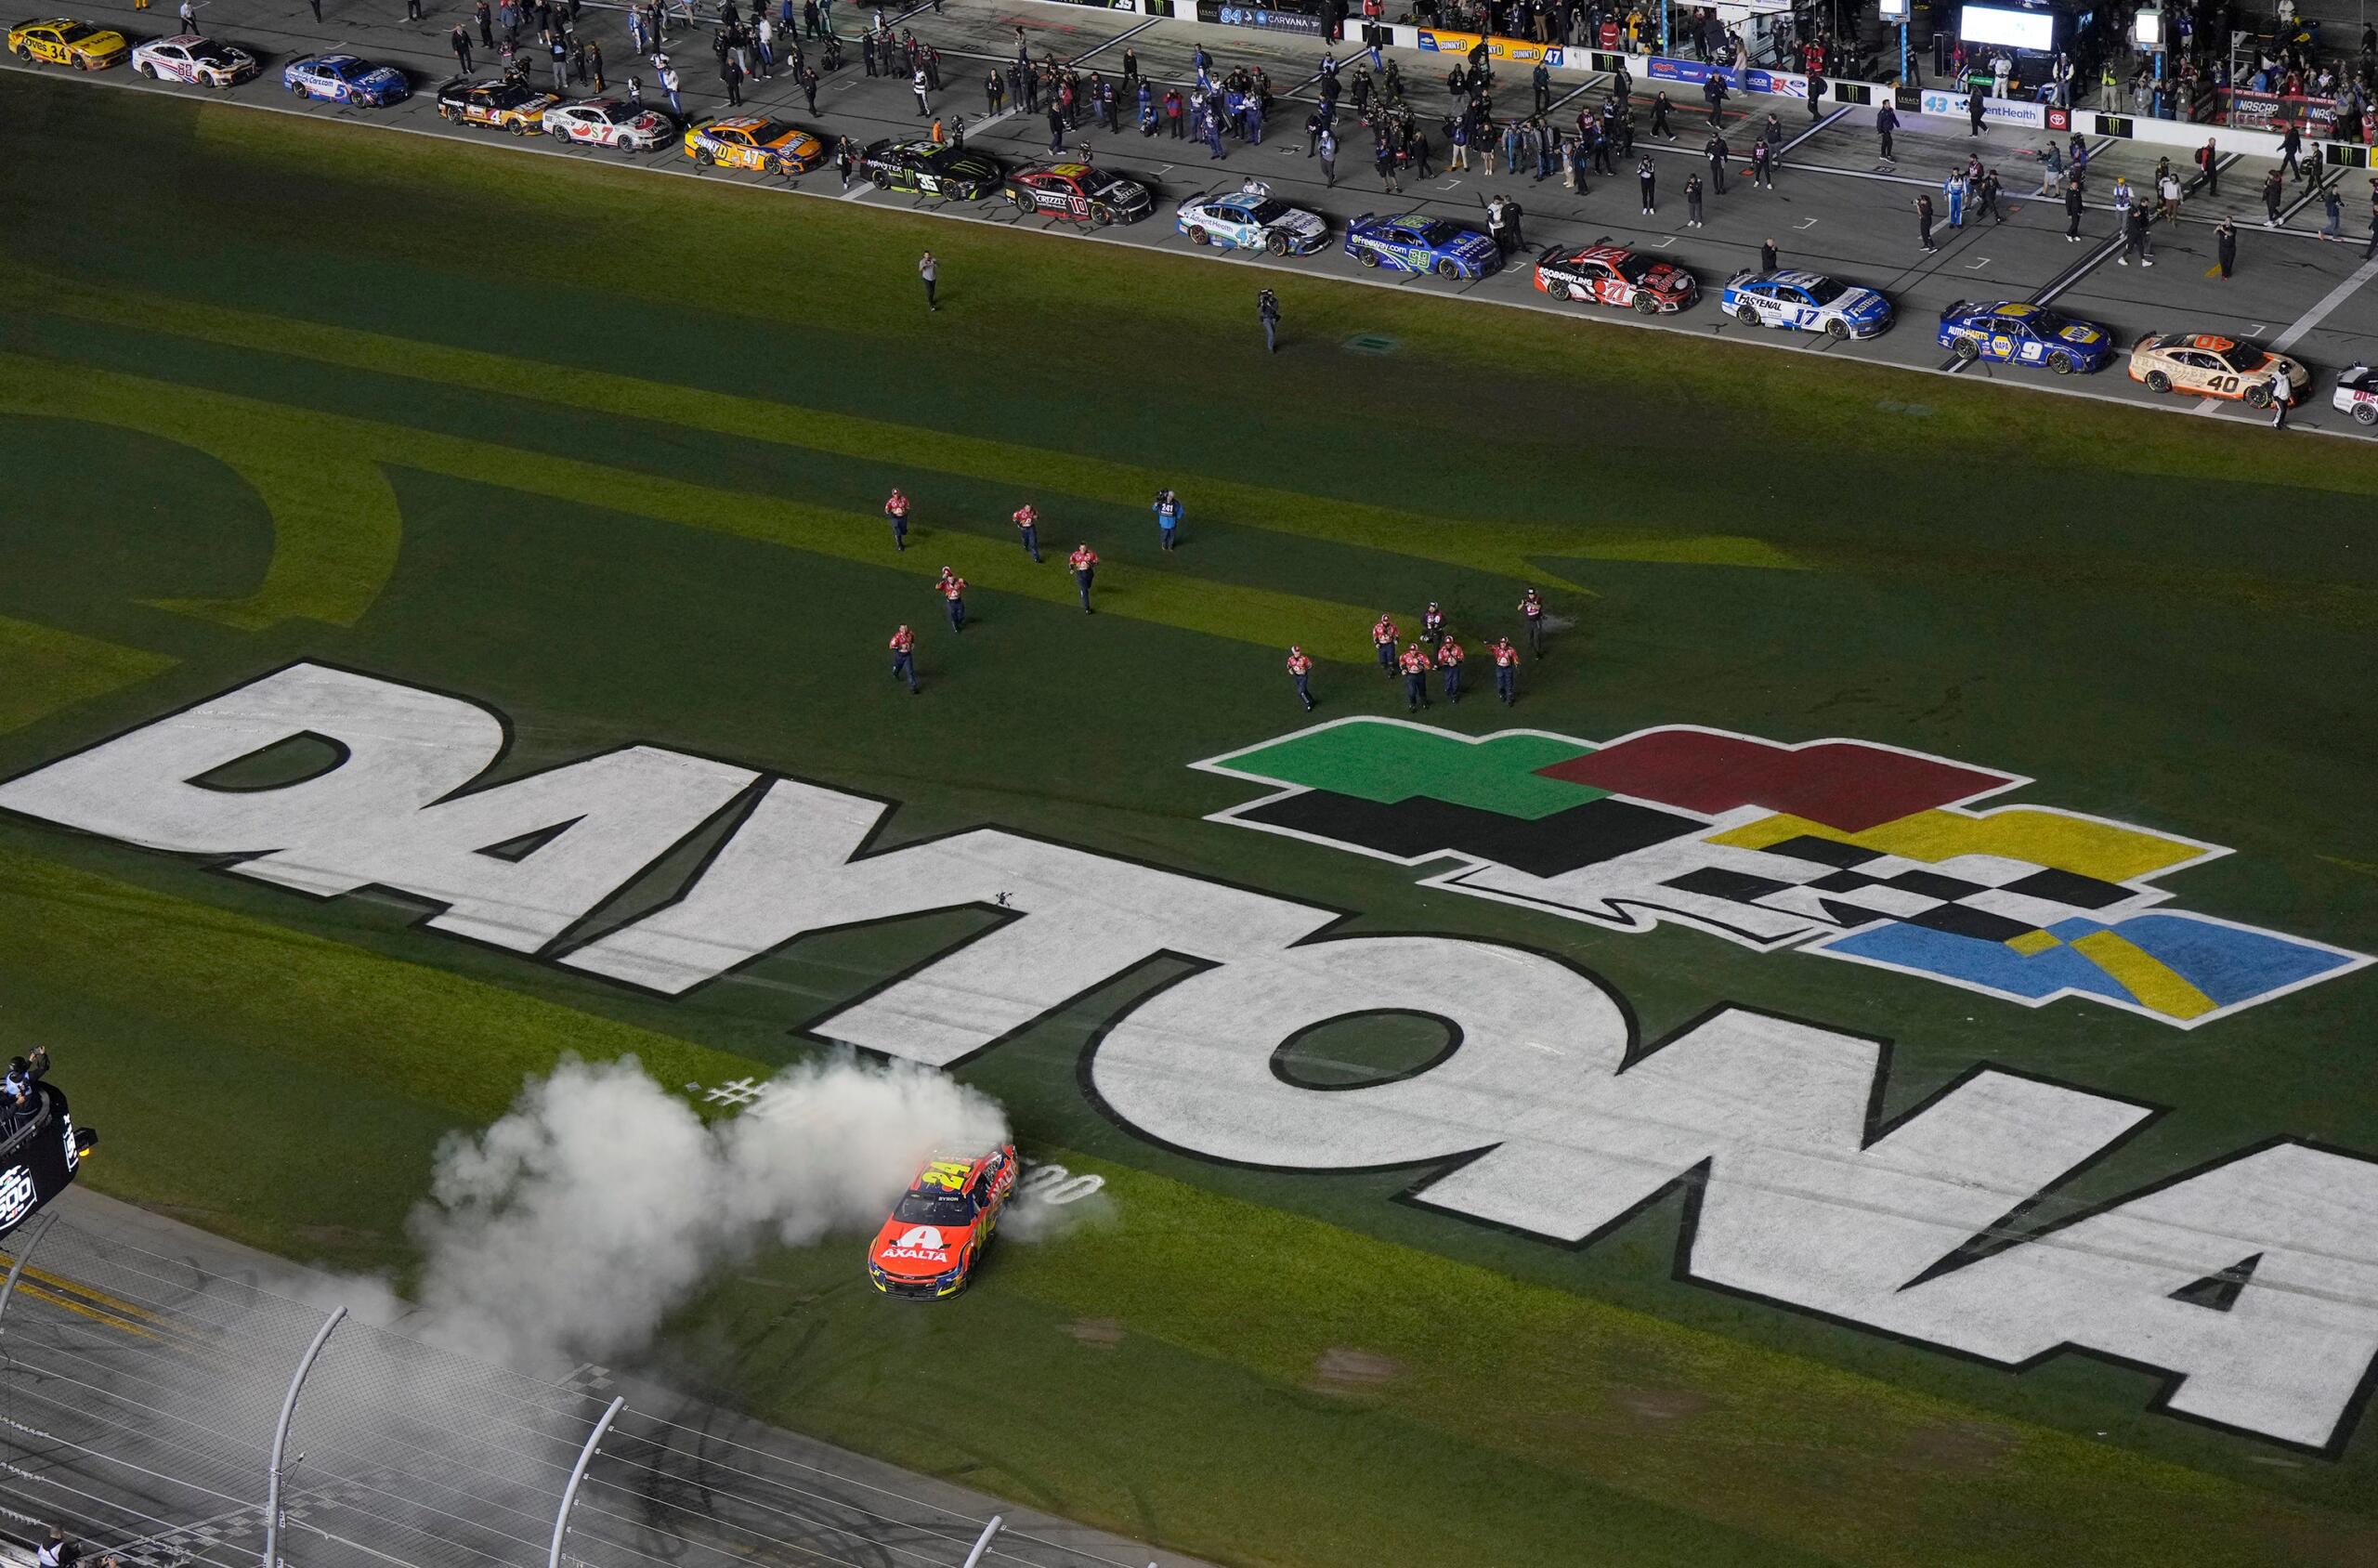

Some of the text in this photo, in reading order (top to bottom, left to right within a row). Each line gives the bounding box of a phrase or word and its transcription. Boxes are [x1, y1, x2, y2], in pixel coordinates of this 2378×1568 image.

[1221, 7, 1242, 24] 84
[1268, 15, 1308, 27] CARVANA
[50, 45, 67, 60] 34
[1545, 47, 1561, 64] 47
[335, 84, 346, 98] 5
[1898, 96, 1920, 104] LEGACY
[1924, 96, 1948, 112] 43
[2239, 99, 2279, 113] NASCAR
[490, 109, 501, 125] 4
[1986, 106, 2036, 120] entHealth
[601, 126, 613, 147] 7
[742, 149, 759, 164] 47
[867, 160, 901, 173] MONSTER
[915, 173, 939, 191] 35
[1036, 193, 1066, 204] GRIZZLY
[1067, 195, 1088, 216] 10
[1189, 213, 1234, 233] AdventHealth
[1357, 236, 1406, 255] Freeway.com
[1407, 249, 1431, 268] 99
[1538, 267, 1593, 287] #GOBOWLING
[1605, 281, 1629, 302] 71
[1737, 294, 1782, 311] FASTENAL
[1794, 308, 1821, 327] 17
[1948, 325, 1989, 341] AUTO PARTS
[1994, 341, 2010, 352] NAPA
[2020, 341, 2043, 360] 9
[2207, 375, 2240, 393] 40
[0, 660, 2378, 1454] DAYTONA
[922, 1161, 973, 1190] 24
[881, 1248, 947, 1263] AXALTA
